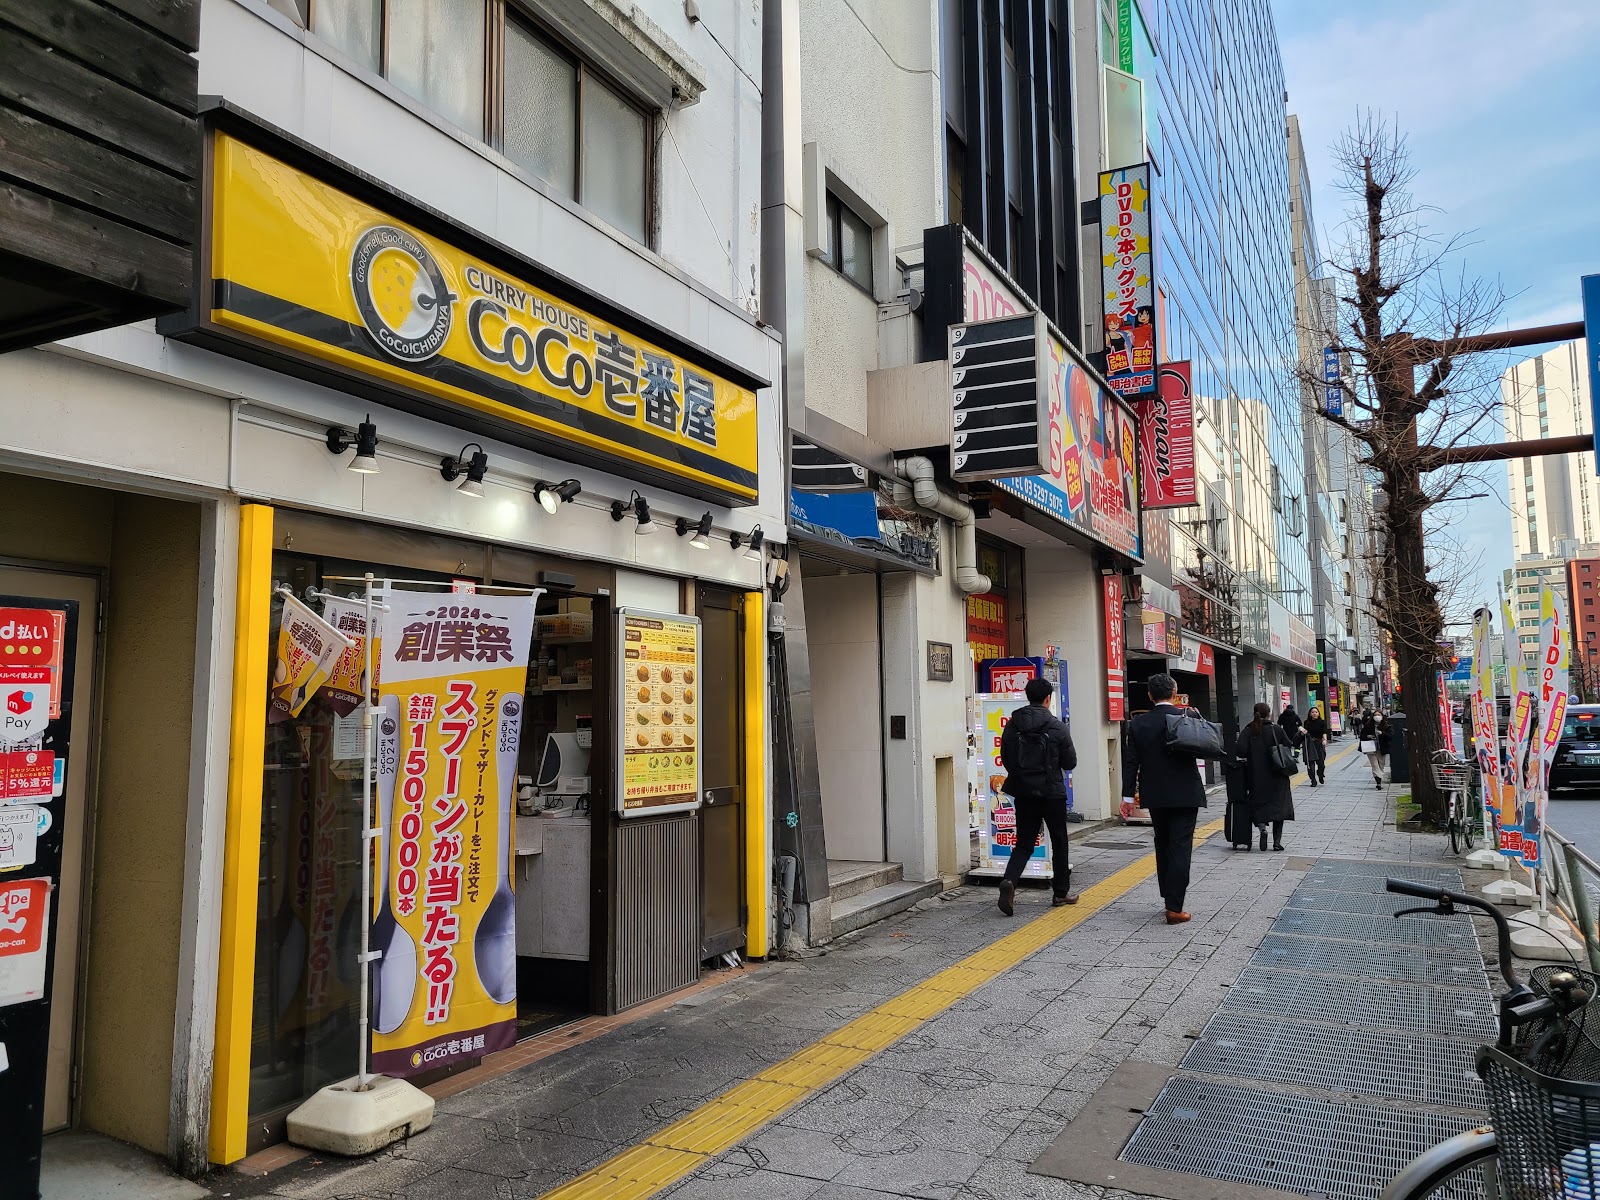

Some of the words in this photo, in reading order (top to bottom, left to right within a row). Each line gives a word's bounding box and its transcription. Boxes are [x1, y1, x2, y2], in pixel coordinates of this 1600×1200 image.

[356, 251, 366, 283] Good
[382, 232, 403, 246] Good
[405, 240, 425, 260] curry
[466, 266, 529, 312] CURRY
[531, 294, 590, 340] HOUSE
[955, 330, 961, 338] 9
[955, 351, 961, 360] 8
[1109, 353, 1126, 364] 24h
[467, 298, 718, 448] CoCo壱番屋
[1111, 361, 1128, 370] OPEN
[955, 373, 961, 382] 7
[1109, 375, 1152, 390] 明治書店
[956, 393, 962, 403] 6
[956, 414, 962, 423] 5
[1170, 398, 1192, 429] GIRL'S
[956, 435, 963, 444] 4
[957, 456, 963, 466] 3
[1171, 436, 1193, 470] DINING
[1068, 479, 1082, 499] OPEN
[1173, 477, 1194, 497] BAR
[1024, 479, 1033, 496] 03
[1034, 483, 1048, 503] 5297
[1049, 493, 1063, 513] 5075
[1090, 468, 1124, 525] 明治書店
[437, 606, 481, 619] 2024
[0, 620, 48, 640] d払い
[395, 620, 514, 663] 創業祭
[409, 694, 435, 707] 全店
[409, 706, 435, 720] 合計
[5, 717, 32, 731] Pay
[507, 719, 519, 753] 2024
[386, 738, 395, 774] 2024
[9, 777, 52, 789] 5%還元
[399, 722, 426, 913] 150,000本
[427, 682, 475, 1021] スプーンが当たる!!
[10, 894, 28, 904] De
[424, 1034, 485, 1062] CoCo壱番屋
